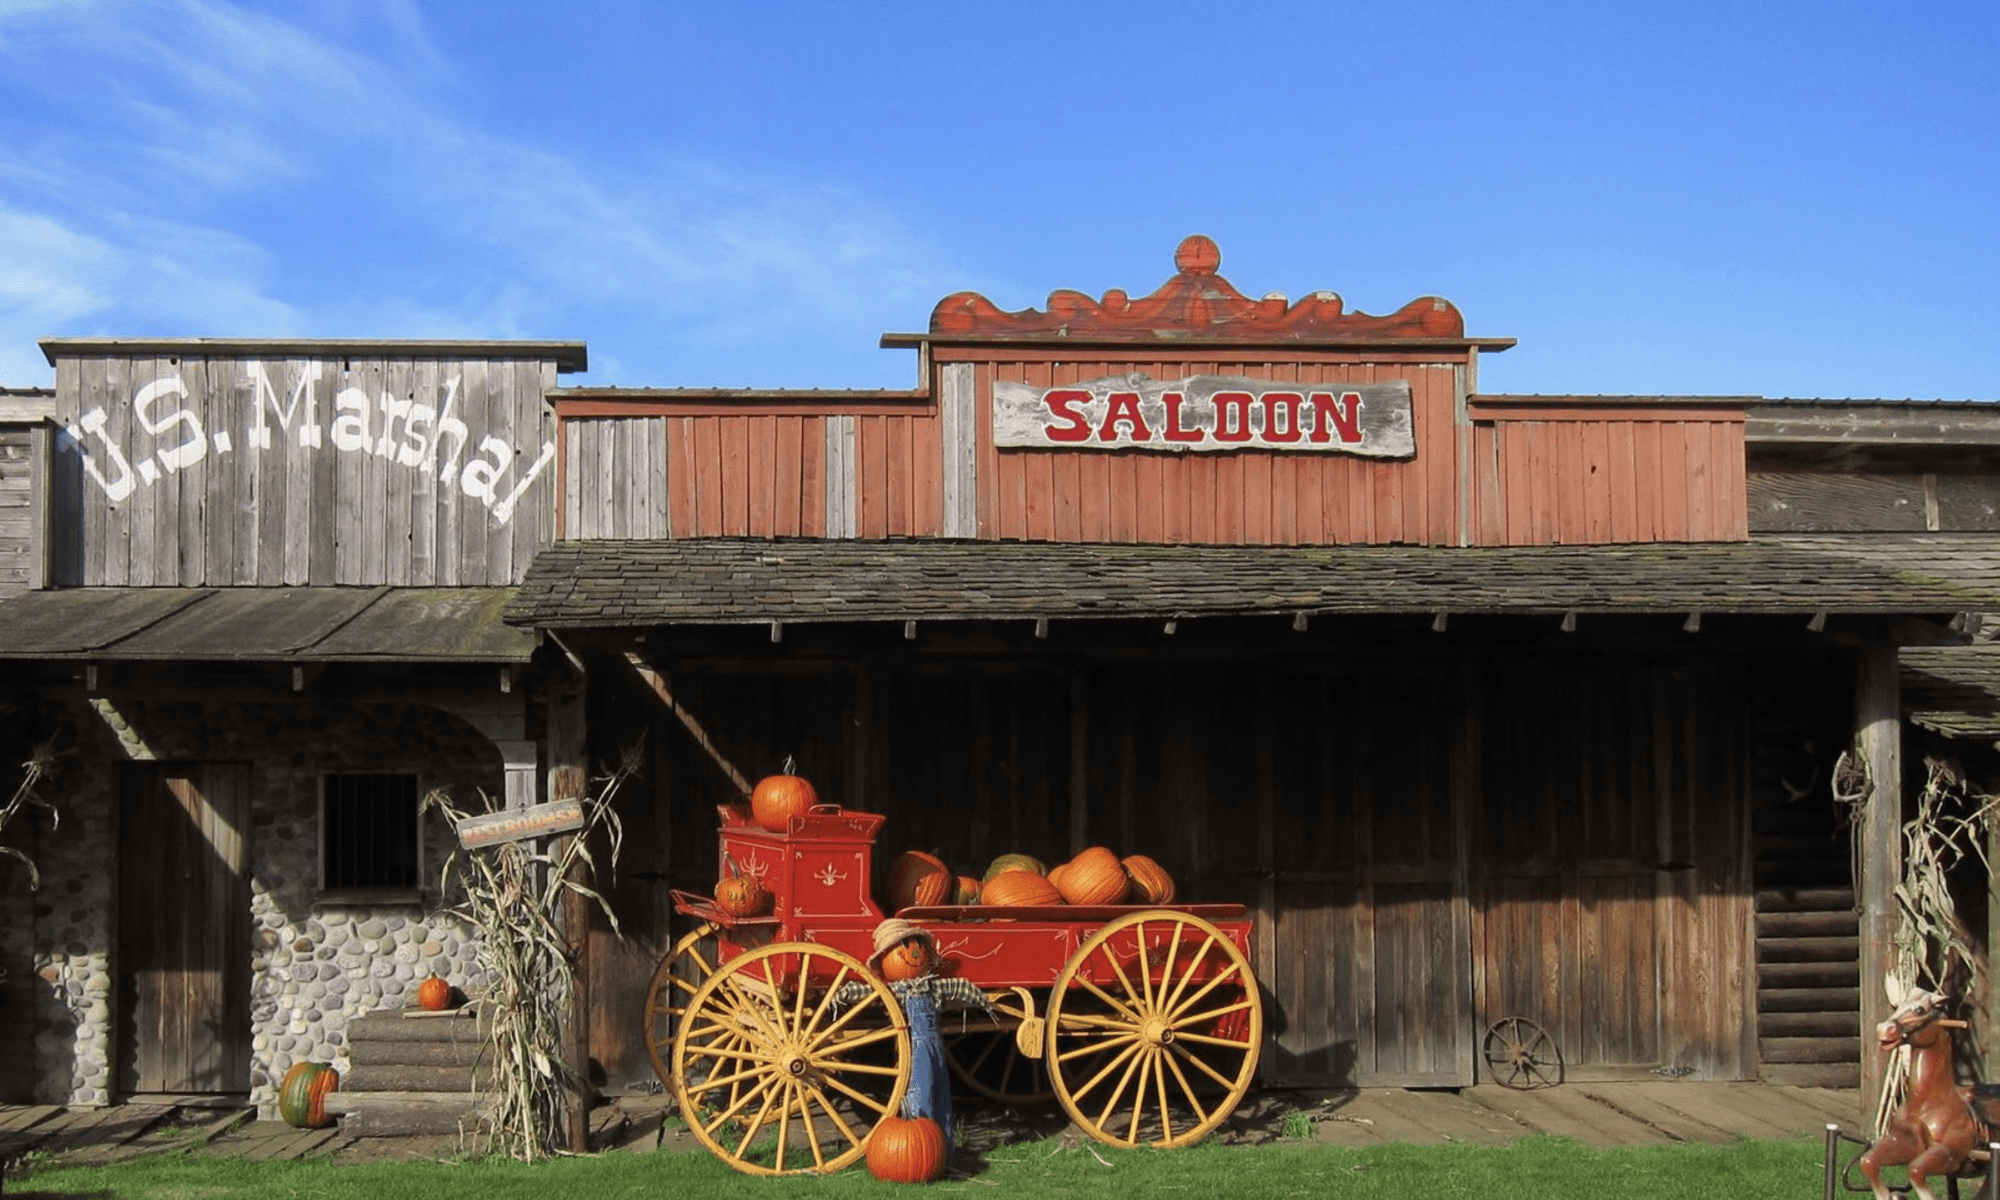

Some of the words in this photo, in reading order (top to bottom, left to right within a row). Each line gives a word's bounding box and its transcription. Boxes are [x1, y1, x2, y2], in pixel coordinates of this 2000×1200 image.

[58, 373, 232, 501] U.S.
[246, 359, 555, 525] Marshal
[1041, 389, 1366, 443] SALOON
